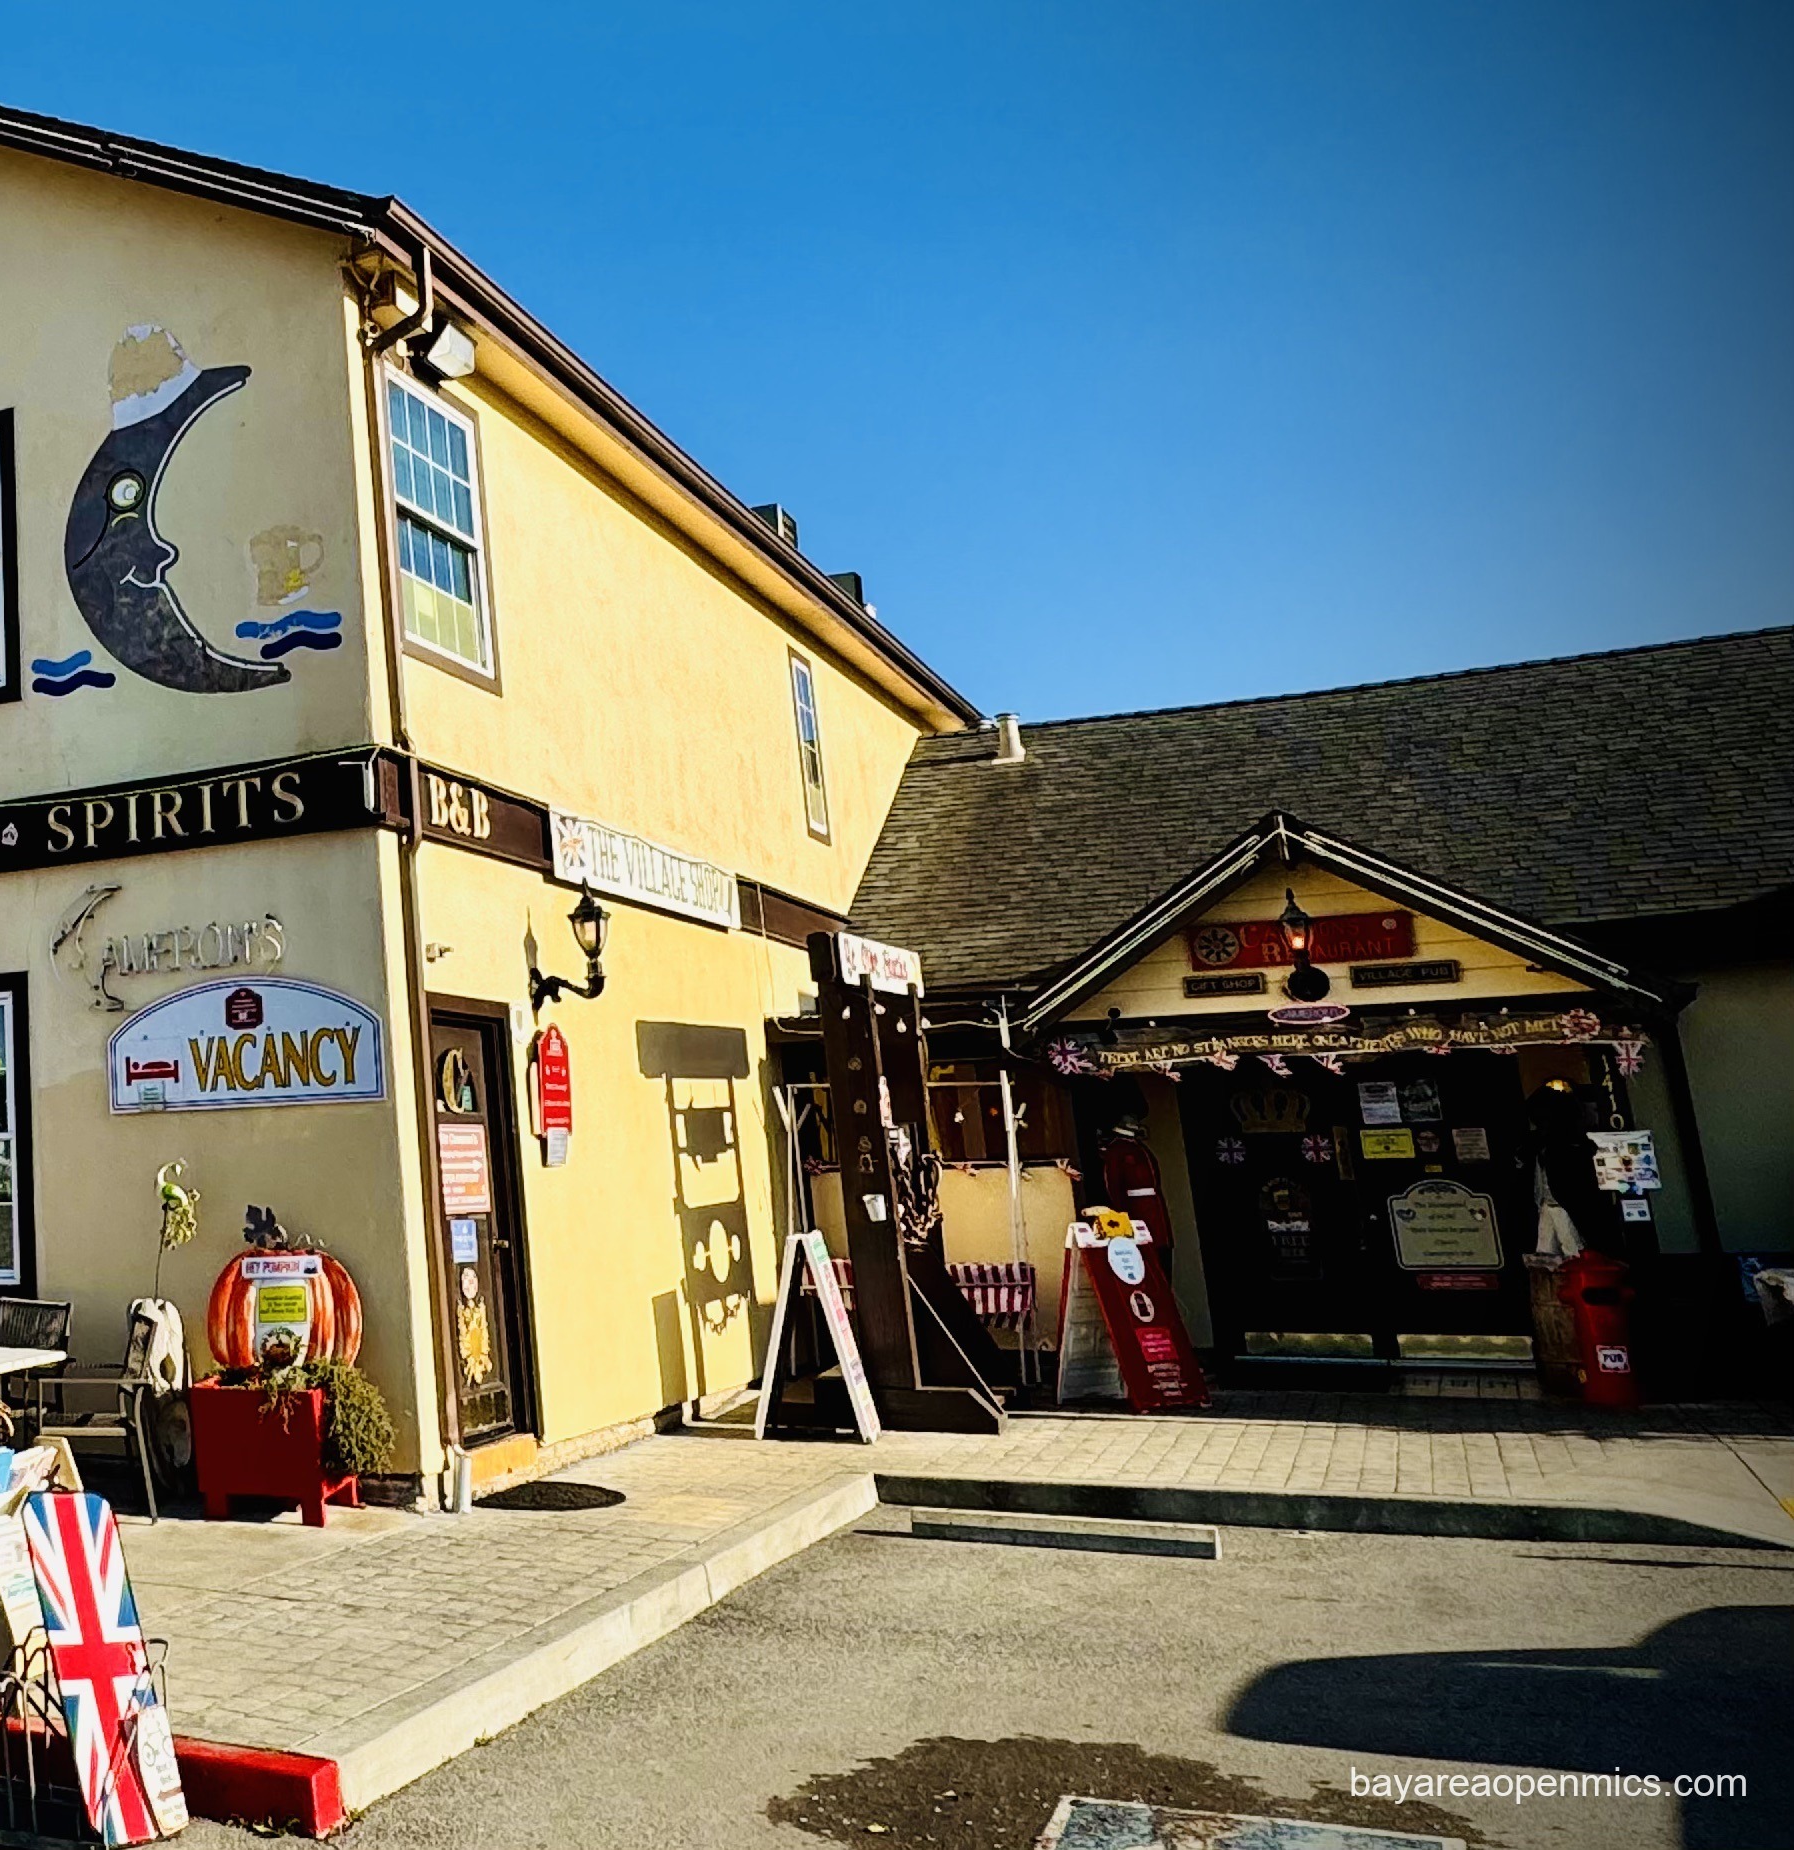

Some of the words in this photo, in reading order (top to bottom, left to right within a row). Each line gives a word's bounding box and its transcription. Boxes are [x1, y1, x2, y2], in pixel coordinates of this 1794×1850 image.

[47, 772, 305, 853] SPIRITS
[426, 774, 491, 839] B&B
[587, 826, 621, 883] THE
[622, 838, 689, 903] VILLAGE
[1359, 968, 1413, 981] VILLAGE
[1421, 966, 1449, 977] PUB
[188, 1025, 362, 1093] VACANCY
[1405, 1026, 1442, 1042] WHO
[1492, 1022, 1521, 1039] NOT
[1603, 1353, 1624, 1363] PUB
